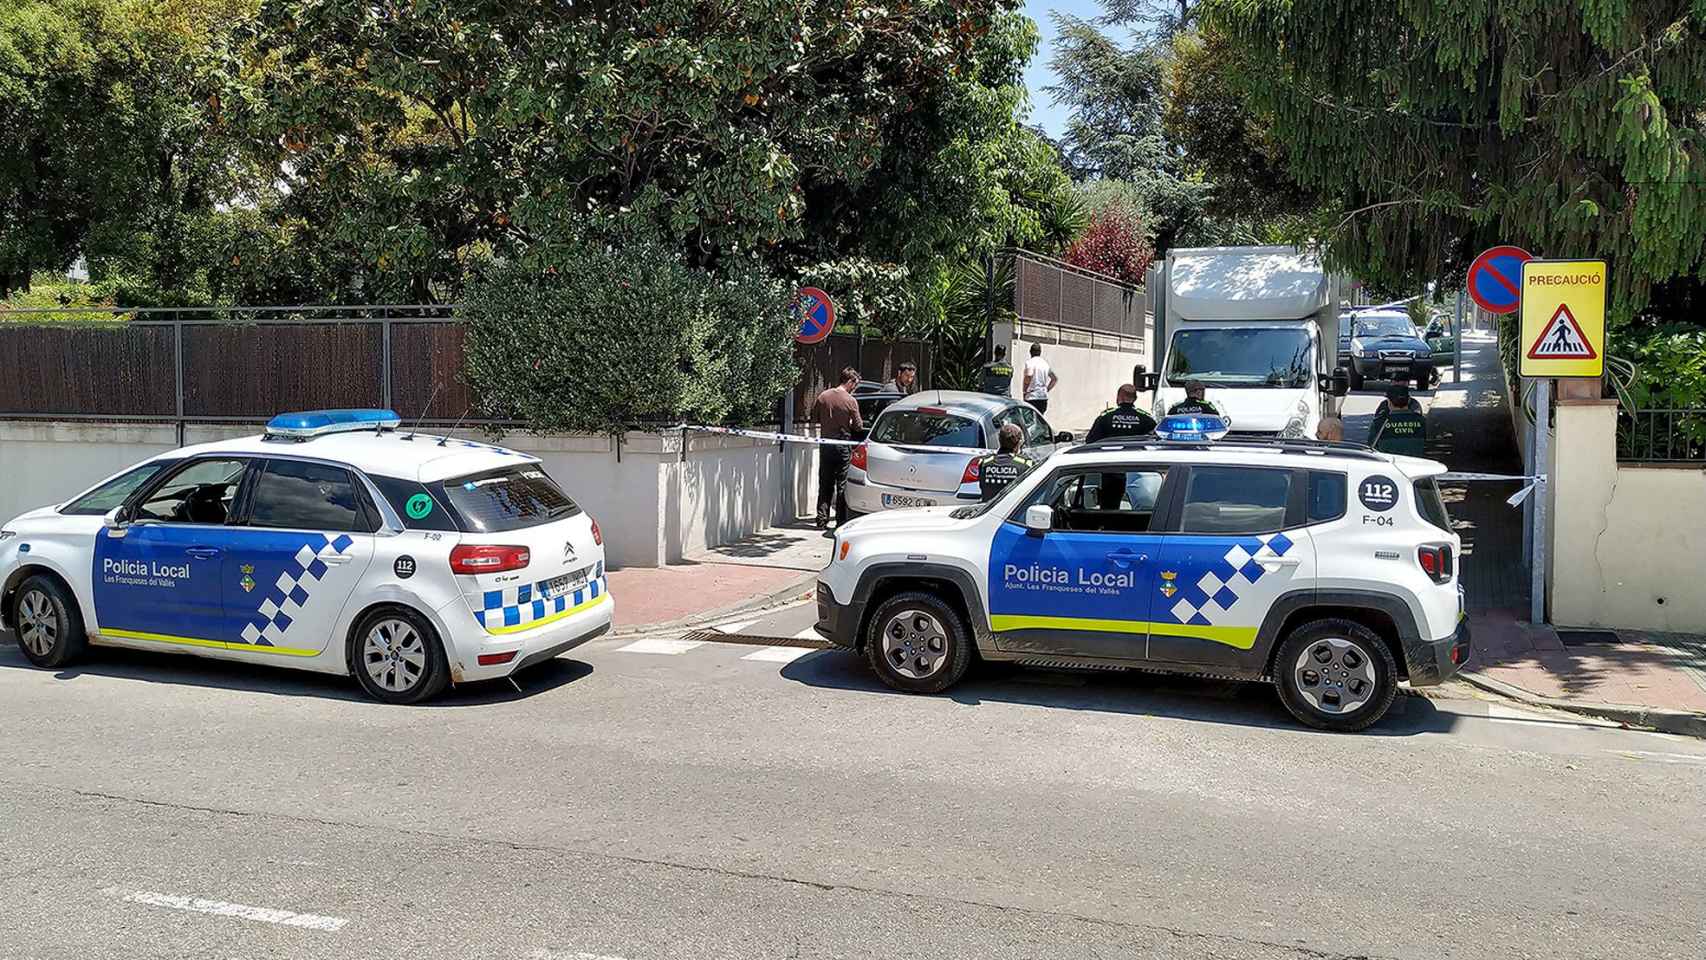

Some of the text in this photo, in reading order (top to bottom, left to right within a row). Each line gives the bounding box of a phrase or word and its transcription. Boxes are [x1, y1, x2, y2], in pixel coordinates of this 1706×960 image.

[1528, 272, 1601, 286] PRECAUCIÓ
[985, 466, 1017, 475] POLICIA
[1364, 483, 1393, 498] 112
[892, 495, 912, 507] 6592
[1362, 515, 1393, 527] F-04
[103, 558, 190, 579] Policia Local
[397, 560, 413, 570] 112
[1004, 562, 1134, 588] Policia Local
[1042, 584, 1083, 593] Franqueses
